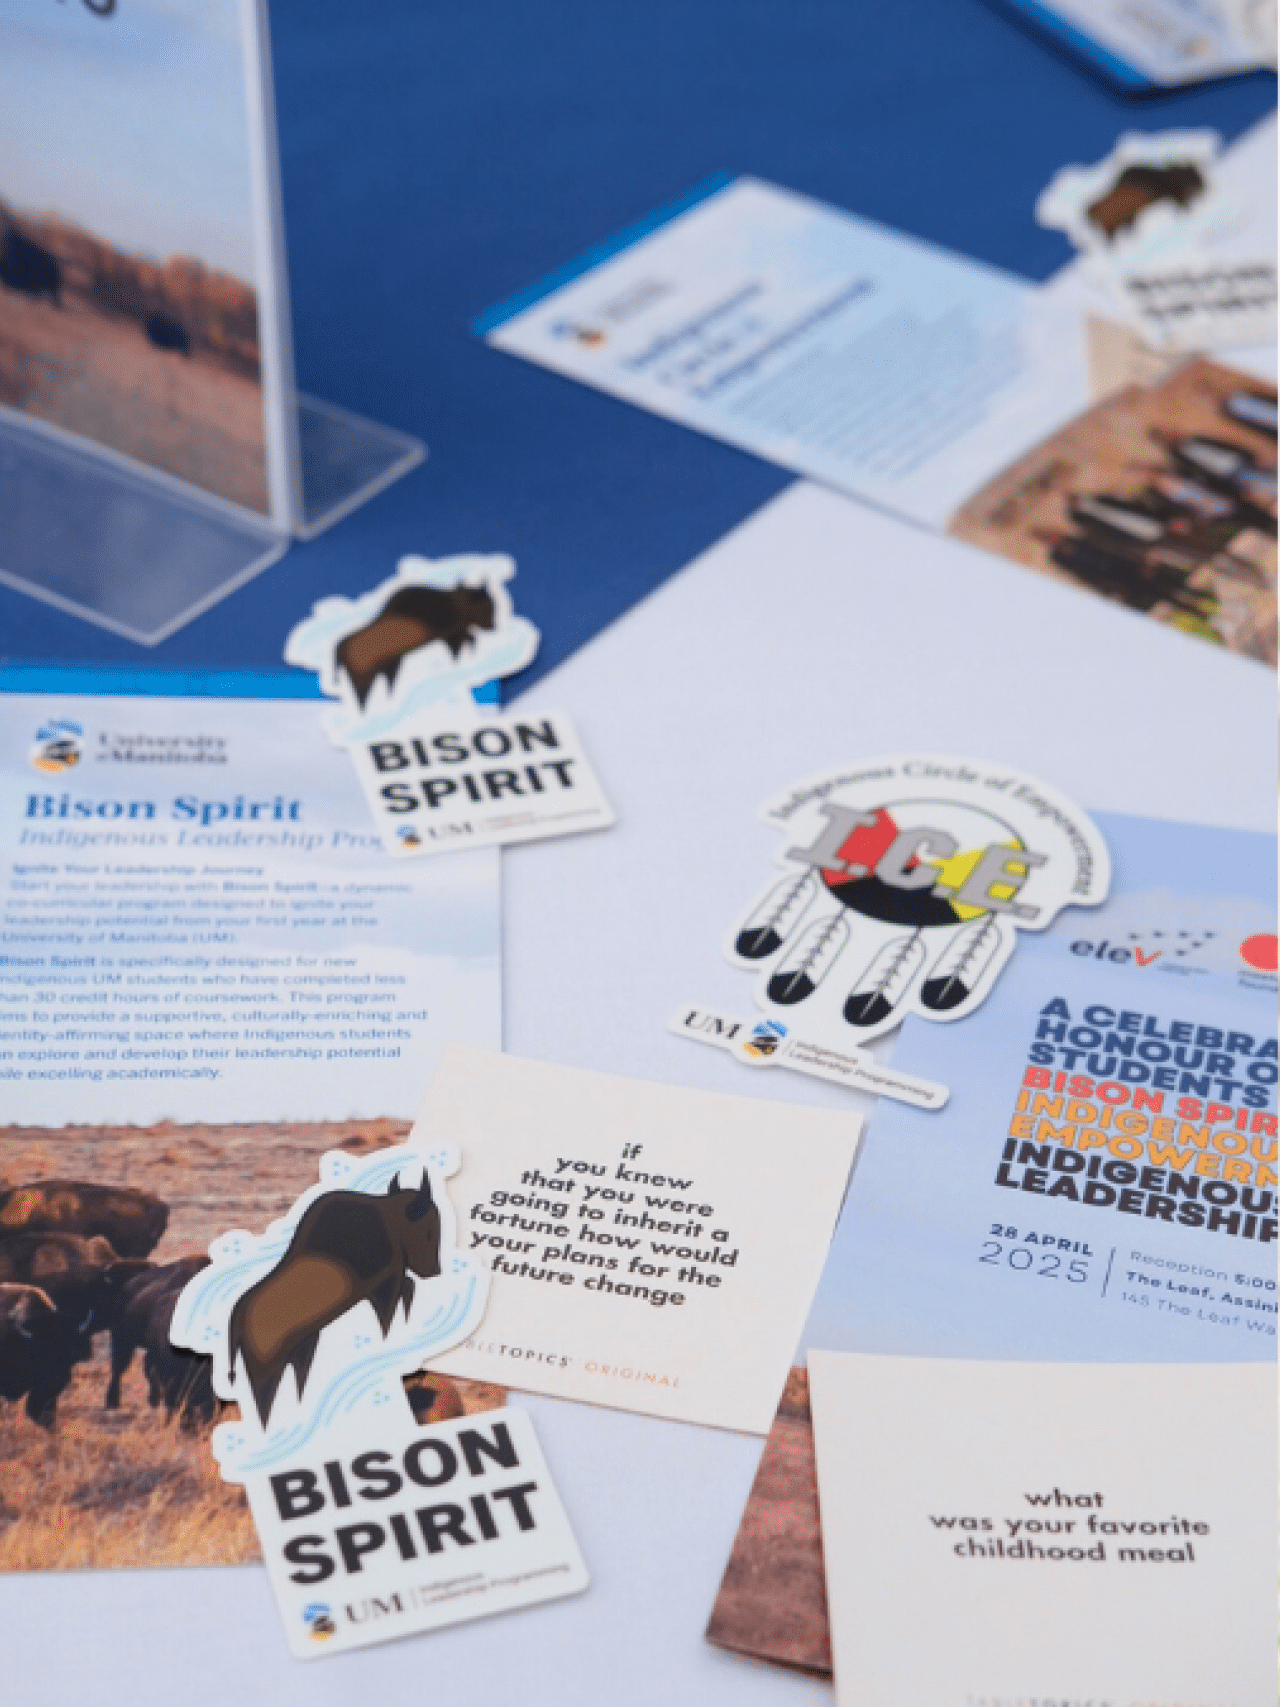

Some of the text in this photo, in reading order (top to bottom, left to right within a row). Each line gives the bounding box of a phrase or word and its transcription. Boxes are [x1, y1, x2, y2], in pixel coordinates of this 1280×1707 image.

[98, 733, 227, 749] University
[369, 719, 561, 773] BISON
[380, 758, 576, 814] SPIRIT
[26, 793, 303, 828] Bison Spirit
[19, 829, 168, 850] Indigenous
[176, 829, 325, 852] Leadership
[134, 1031, 185, 1043] space
[187, 1029, 239, 1041] where
[338, 1028, 413, 1041] students
[683, 1009, 743, 1039] UM
[1039, 996, 1278, 1061] A CELEBRA
[17, 1048, 80, 1063] explore
[83, 1047, 118, 1061] and
[121, 1047, 189, 1063] develop
[192, 1047, 231, 1060] their
[235, 1046, 323, 1060] leadership
[326, 1046, 402, 1060] potential
[1034, 1018, 1237, 1077] HONOUR
[1027, 1041, 1270, 1109] STUDENTS
[1022, 1064, 1278, 1138] BISON SPIR
[1015, 1088, 1278, 1163] INDIGENOU
[620, 1142, 643, 1160] if
[521, 1169, 715, 1217] that you were
[553, 1157, 694, 1190] you knew
[1000, 1137, 1278, 1216] INDIGENOU
[468, 1202, 740, 1268] fortune how would
[489, 1190, 730, 1243] going to inherit a
[468, 1230, 723, 1288] your plans for the
[988, 1223, 1094, 1257] 28 APRIL
[490, 1253, 687, 1308] future change
[978, 1240, 1090, 1284] 2025
[1126, 1269, 1161, 1288] The
[1130, 1250, 1228, 1281] Reception
[1158, 1299, 1191, 1316] The
[268, 1420, 521, 1522] BISON
[1023, 1486, 1105, 1508] what
[282, 1480, 539, 1586] SPIRIT
[928, 1514, 1211, 1538] was your favorite
[952, 1536, 1197, 1563] childhood meal
[345, 1591, 404, 1624] UM
